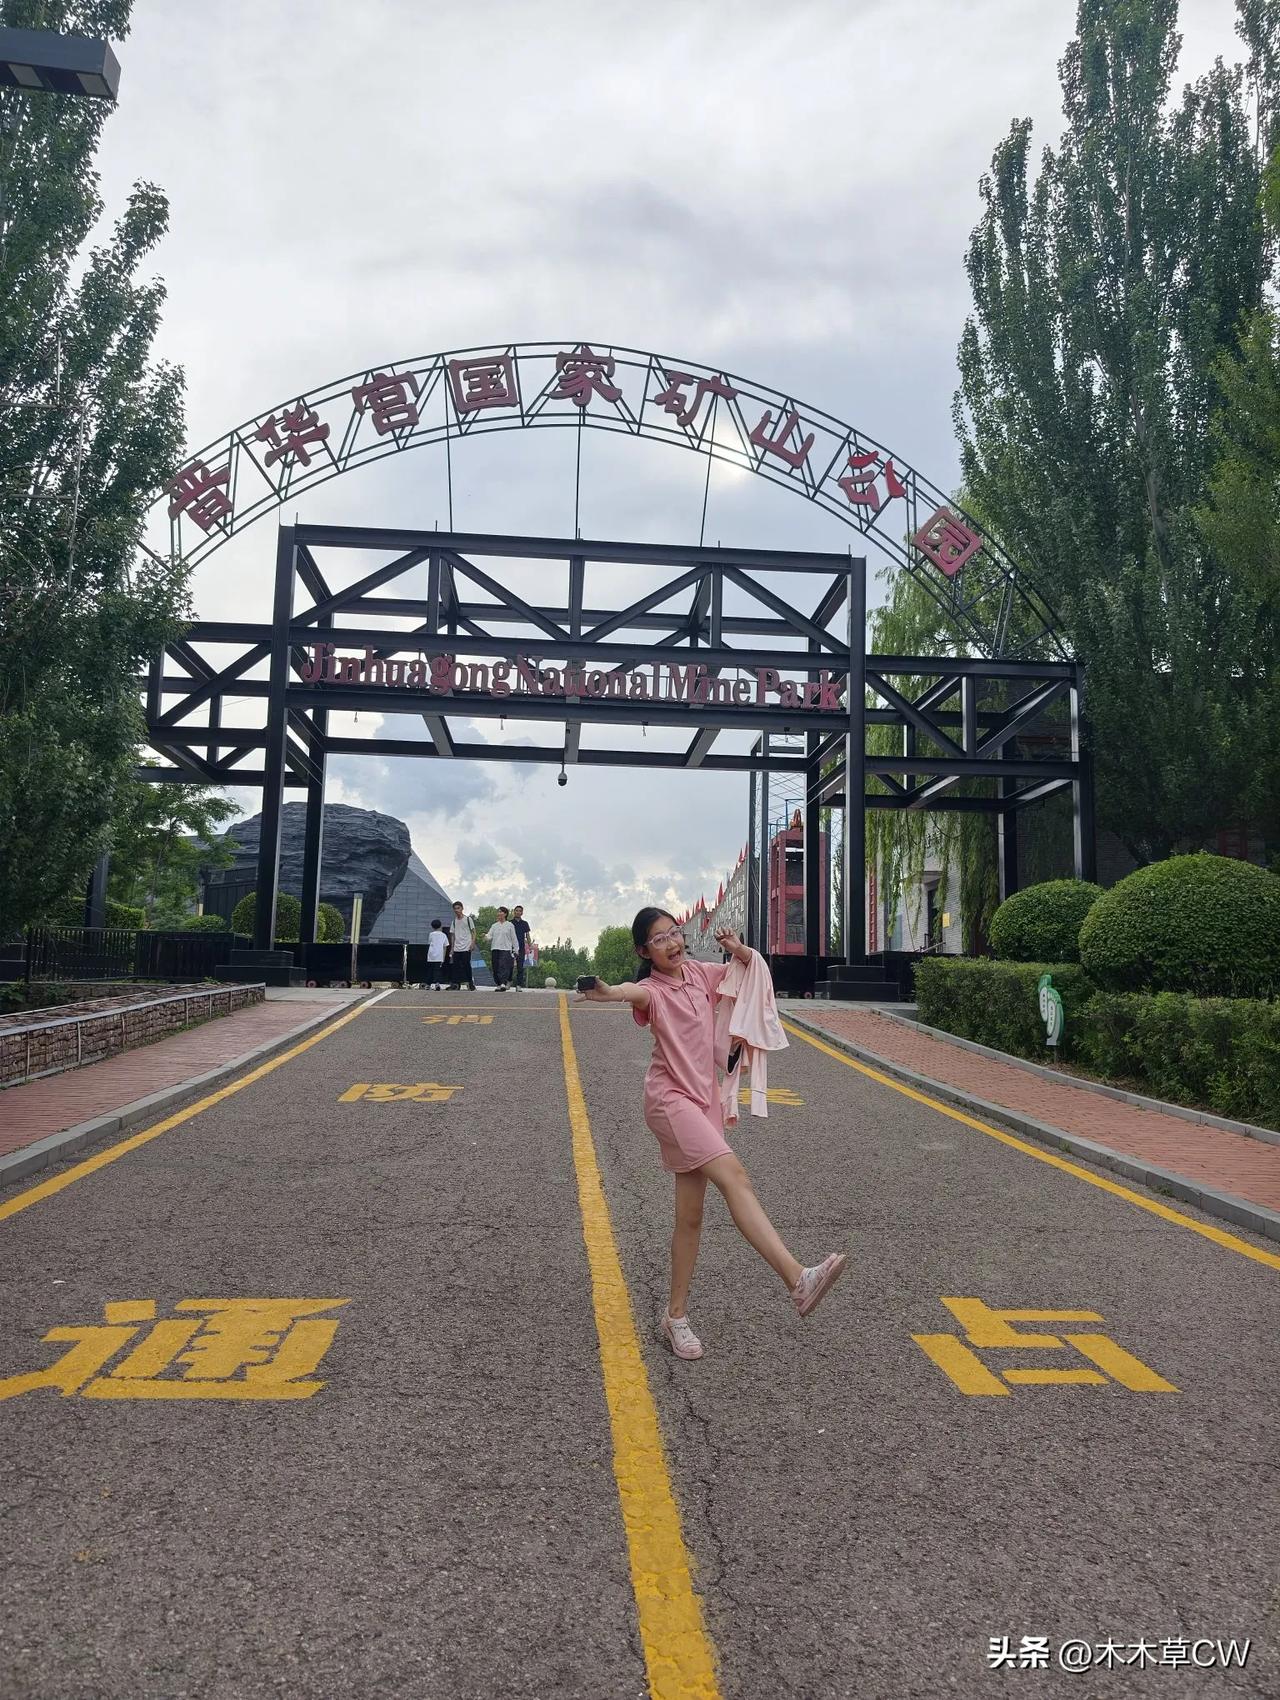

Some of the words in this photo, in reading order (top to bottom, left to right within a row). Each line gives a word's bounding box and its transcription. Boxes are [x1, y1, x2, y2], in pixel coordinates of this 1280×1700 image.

[163, 345, 982, 577] 晋华宫国家矿山公园
[301, 643, 513, 698] Jinhuagong
[516, 654, 661, 700] National
[667, 662, 751, 706] Mine
[755, 667, 841, 711] Park
[0, 1298, 351, 1400] 通
[910, 1296, 1182, 1396] 占
